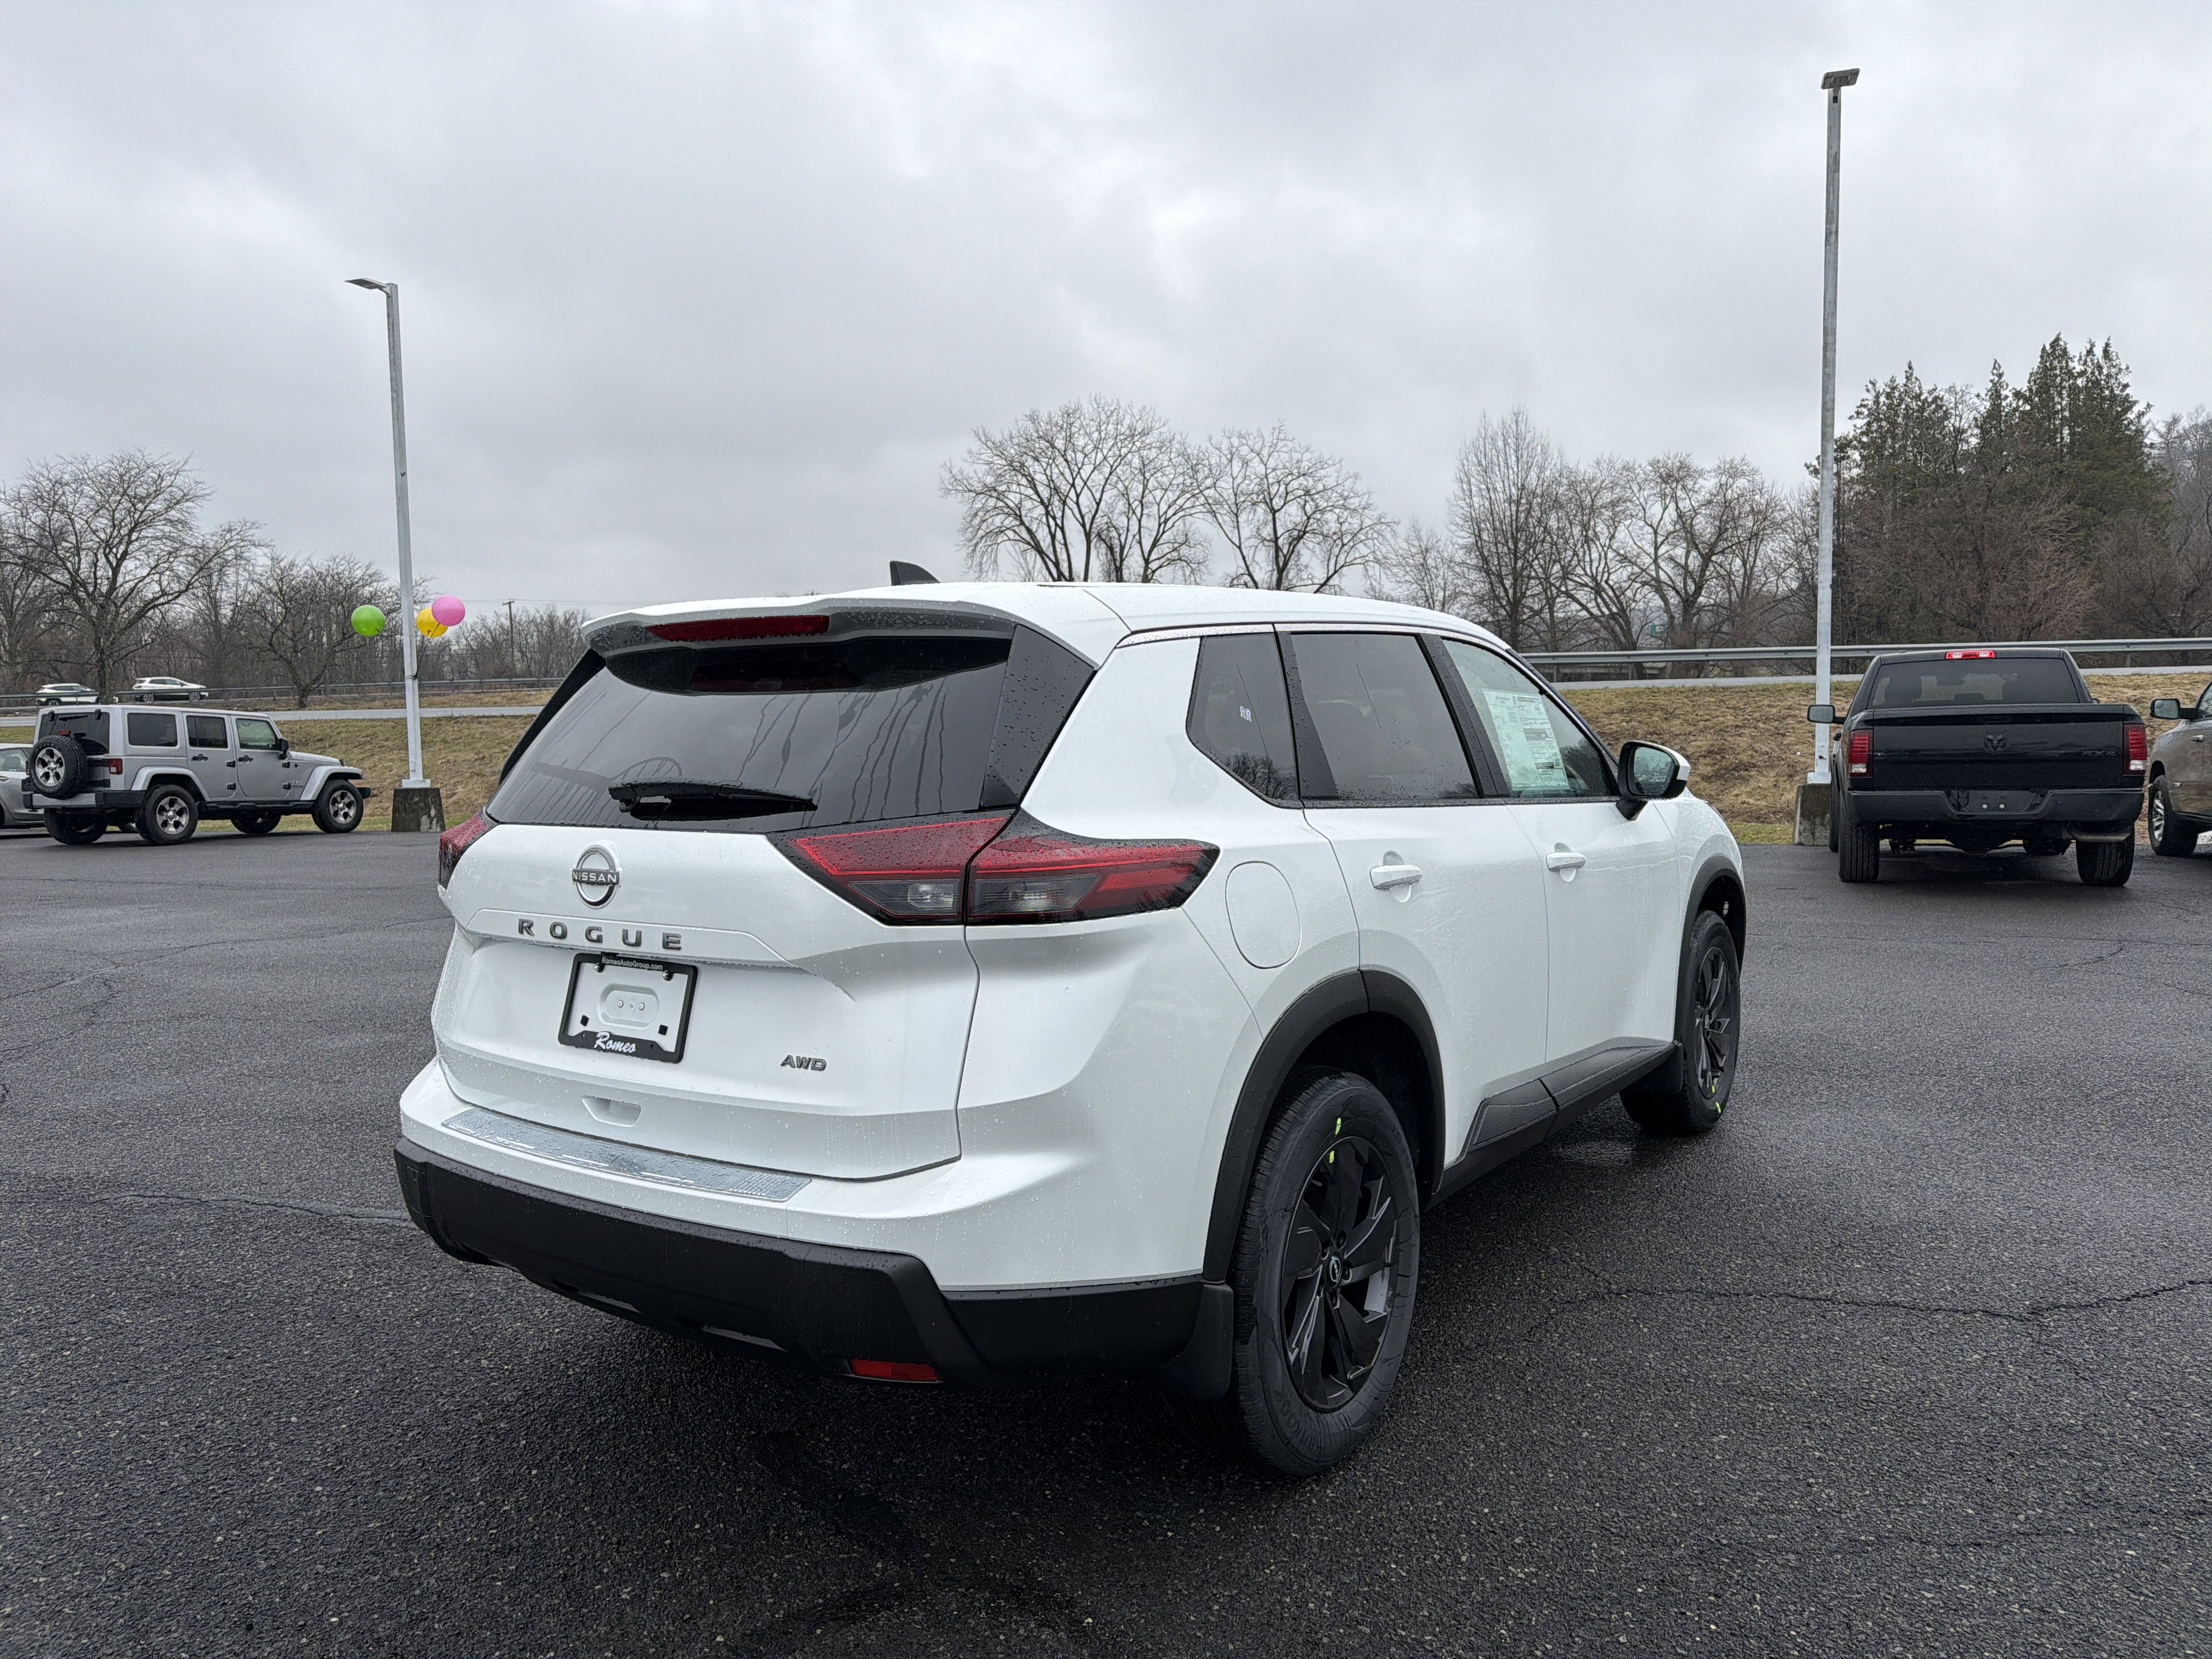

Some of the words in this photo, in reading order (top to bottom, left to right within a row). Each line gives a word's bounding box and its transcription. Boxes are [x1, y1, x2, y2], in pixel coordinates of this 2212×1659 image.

[572, 871, 617, 883] NISSAN
[518, 918, 681, 951] ROGUE
[602, 957, 663, 970] RomeoAutoGroup.com
[594, 1031, 636, 1053] Romeo
[780, 1054, 827, 1071] AWD
